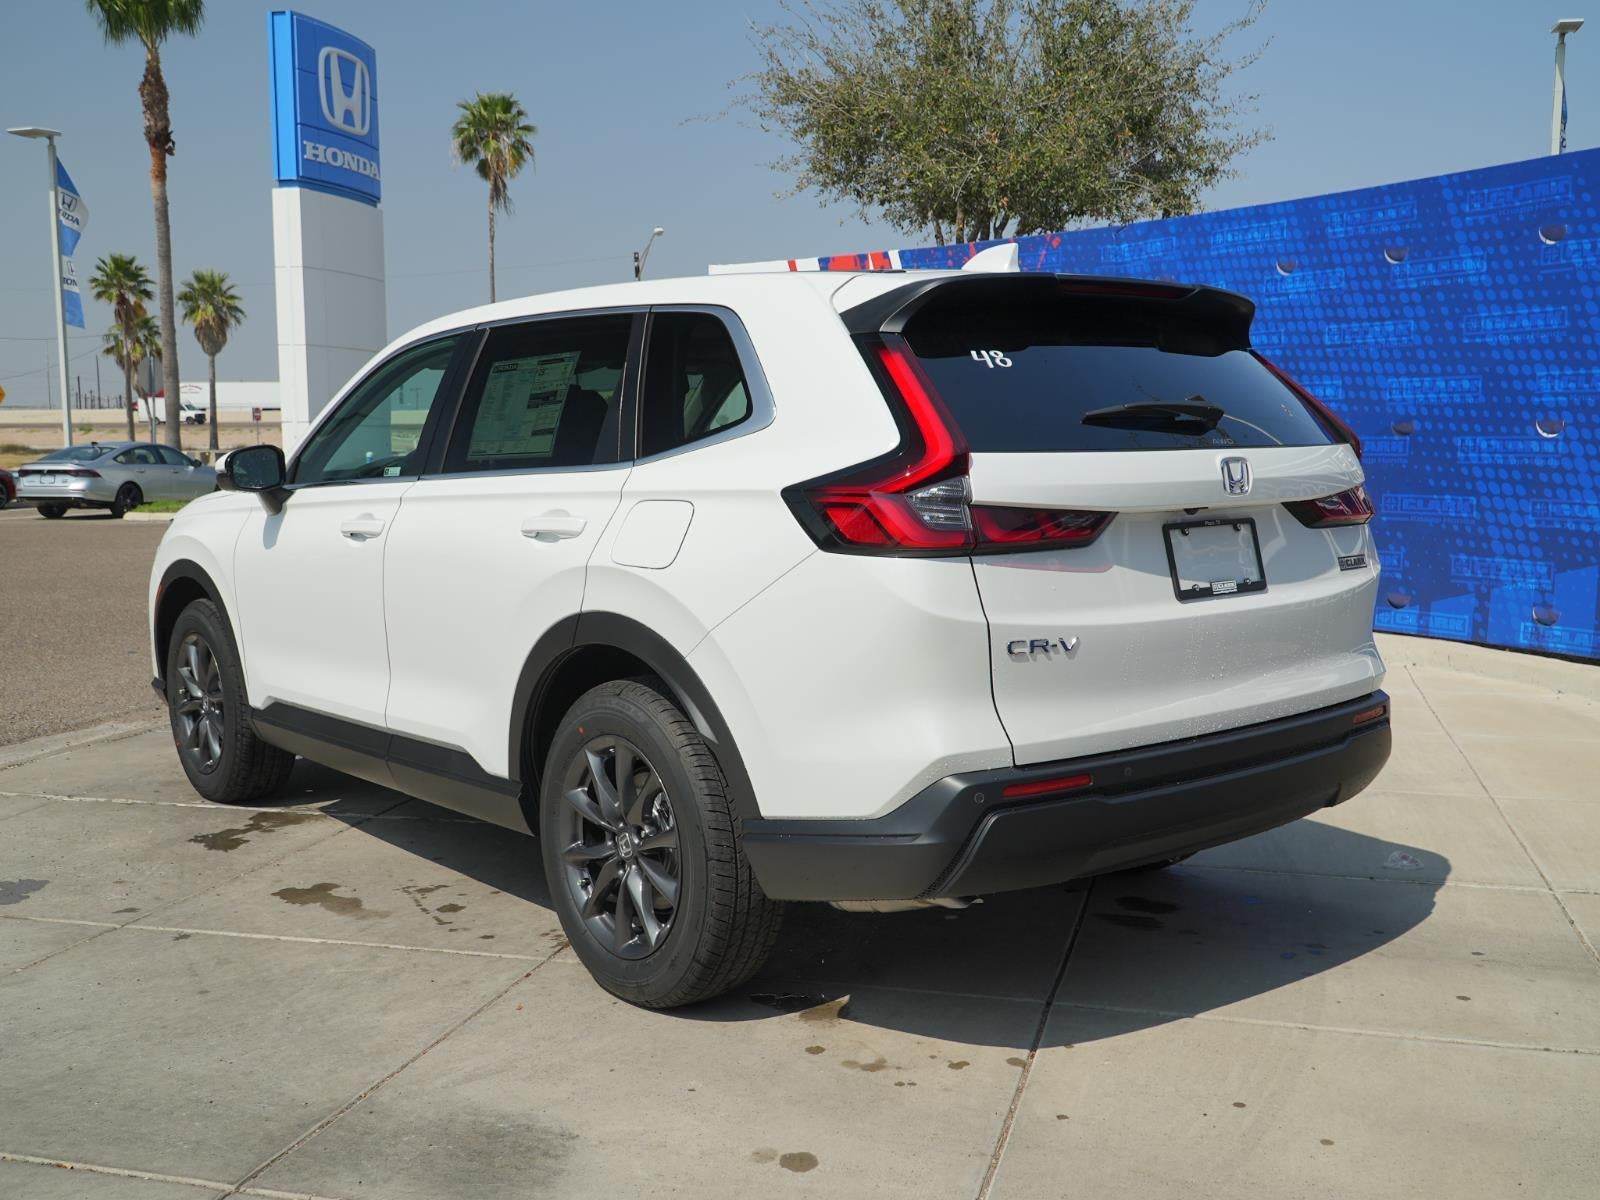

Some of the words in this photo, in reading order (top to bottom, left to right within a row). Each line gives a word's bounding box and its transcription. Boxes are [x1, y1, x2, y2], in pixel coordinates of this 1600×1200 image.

[303, 140, 382, 181] HONDA
[970, 349, 1013, 369] 48
[1402, 497, 1471, 513] CLARK
[1007, 637, 1079, 655] CR-V
